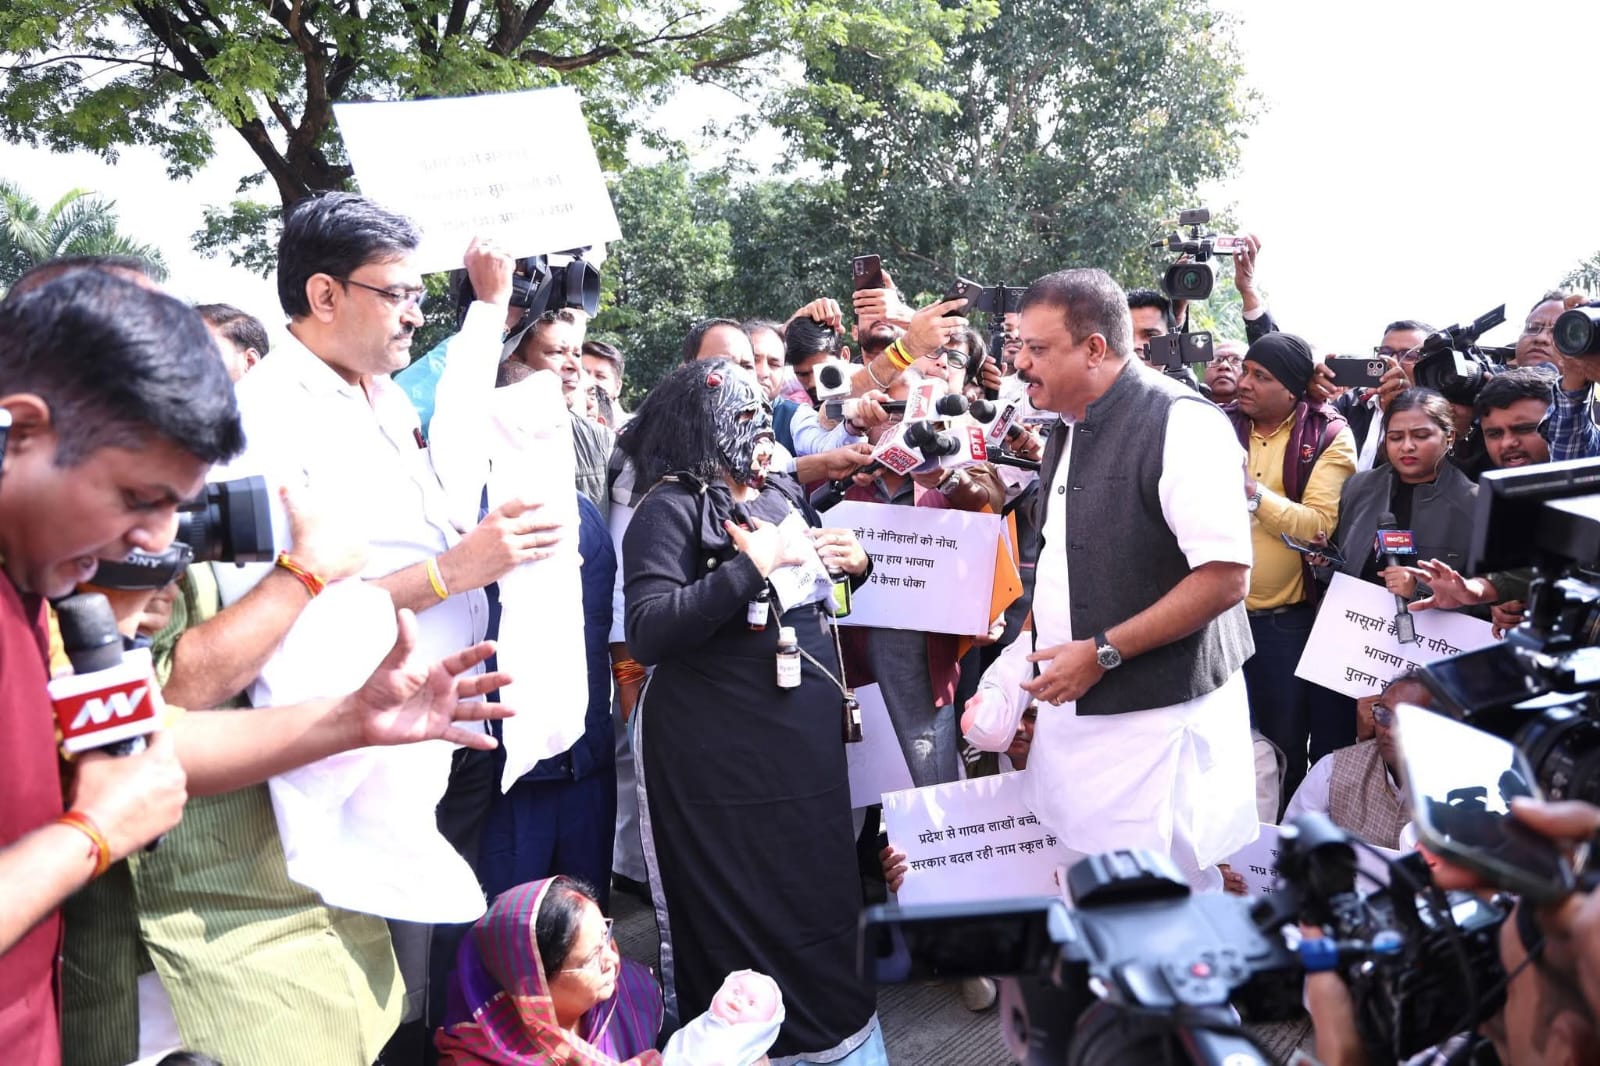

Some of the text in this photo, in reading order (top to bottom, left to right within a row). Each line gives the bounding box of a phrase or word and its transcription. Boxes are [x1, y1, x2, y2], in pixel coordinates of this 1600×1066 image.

[867, 528, 875, 541] ने
[920, 534, 933, 547] को
[935, 535, 959, 551] नोचा,
[127, 554, 161, 569] ONY
[886, 554, 902, 566] हाय
[905, 556, 936, 569] भाजपा
[880, 573, 900, 587] कैसा
[903, 575, 927, 589] धोका
[1344, 609, 1386, 632] मासूमों
[1364, 645, 1404, 668] भाजपा
[1344, 666, 1379, 688] पुतना
[918, 829, 944, 845] प्रदेश
[946, 826, 956, 840] से
[987, 815, 1016, 832] लाखों
[910, 834, 1058, 871] सरकार बदल रही नाम स्कूल के
[1248, 865, 1266, 875] मप्र
